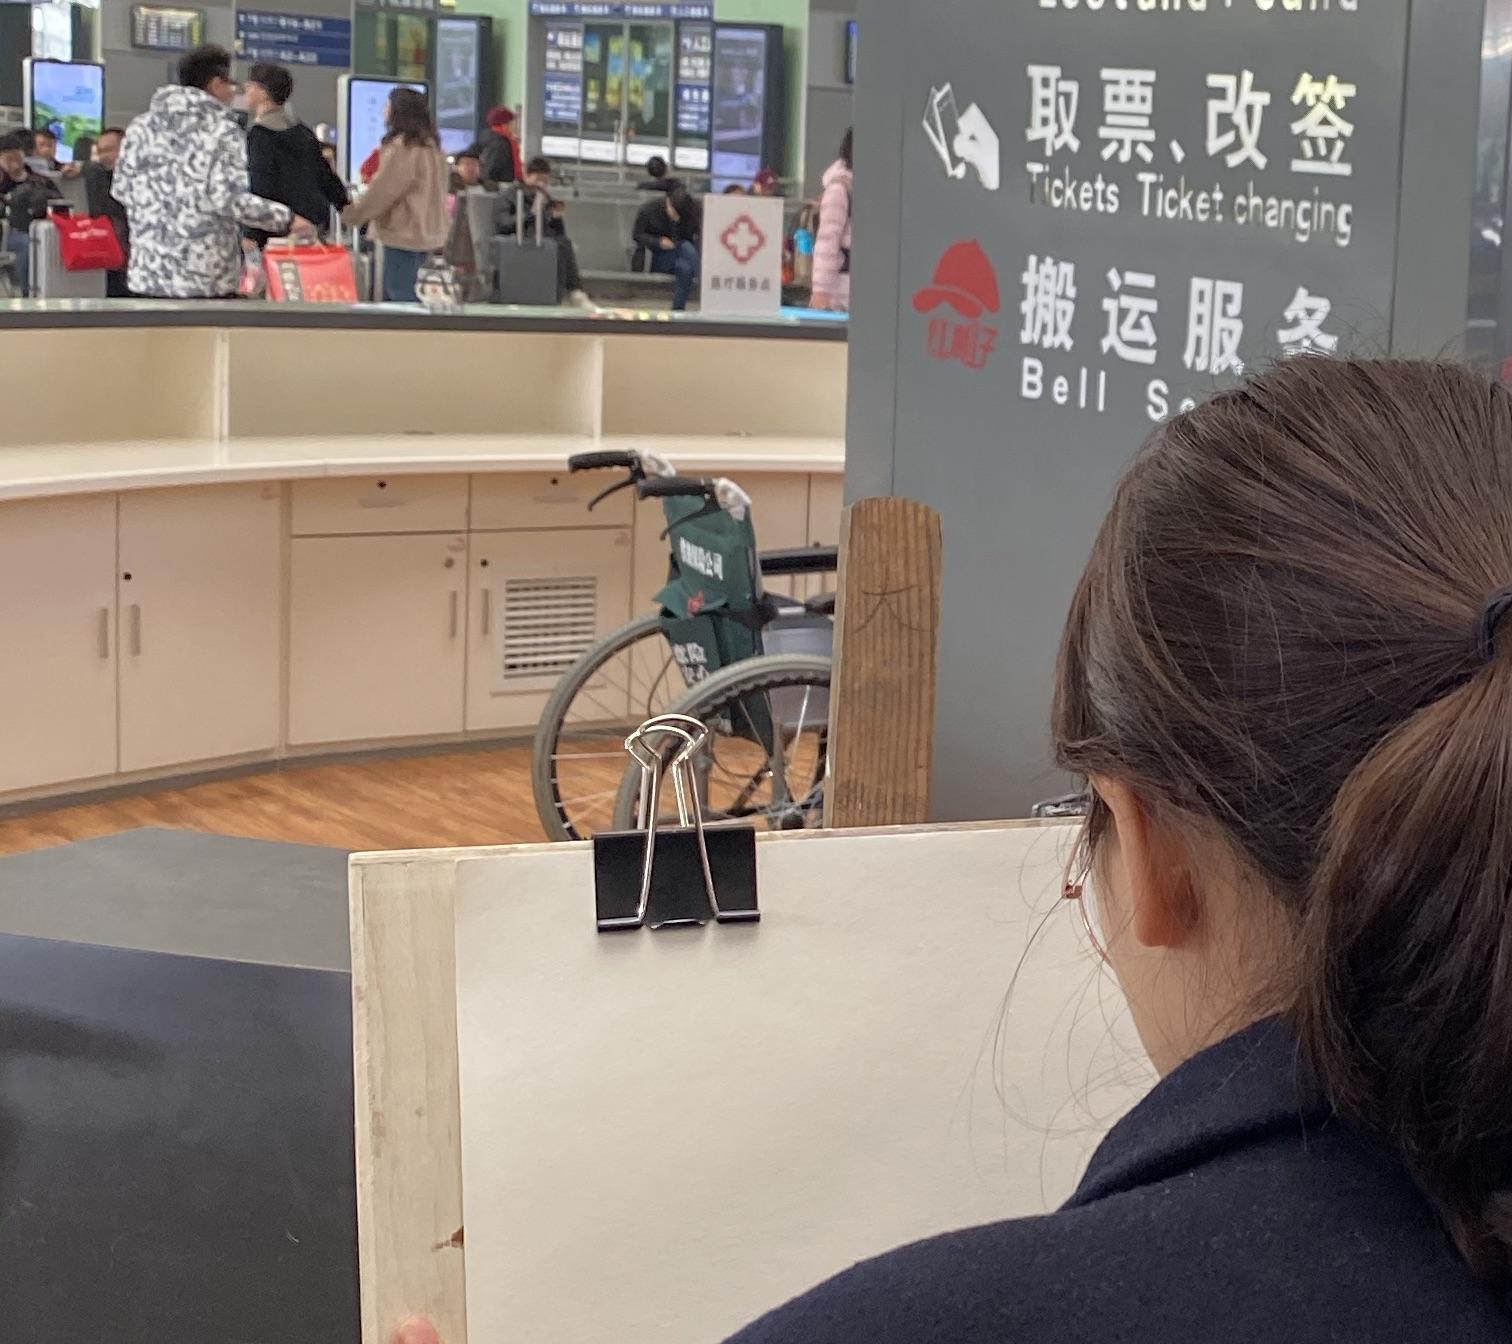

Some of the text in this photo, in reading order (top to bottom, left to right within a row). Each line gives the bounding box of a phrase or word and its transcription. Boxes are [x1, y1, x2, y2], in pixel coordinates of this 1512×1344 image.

[1025, 63, 1357, 177] 取票、改签
[1025, 161, 1354, 247] Tickets Ticket changing
[1021, 357, 1107, 413] Bell
